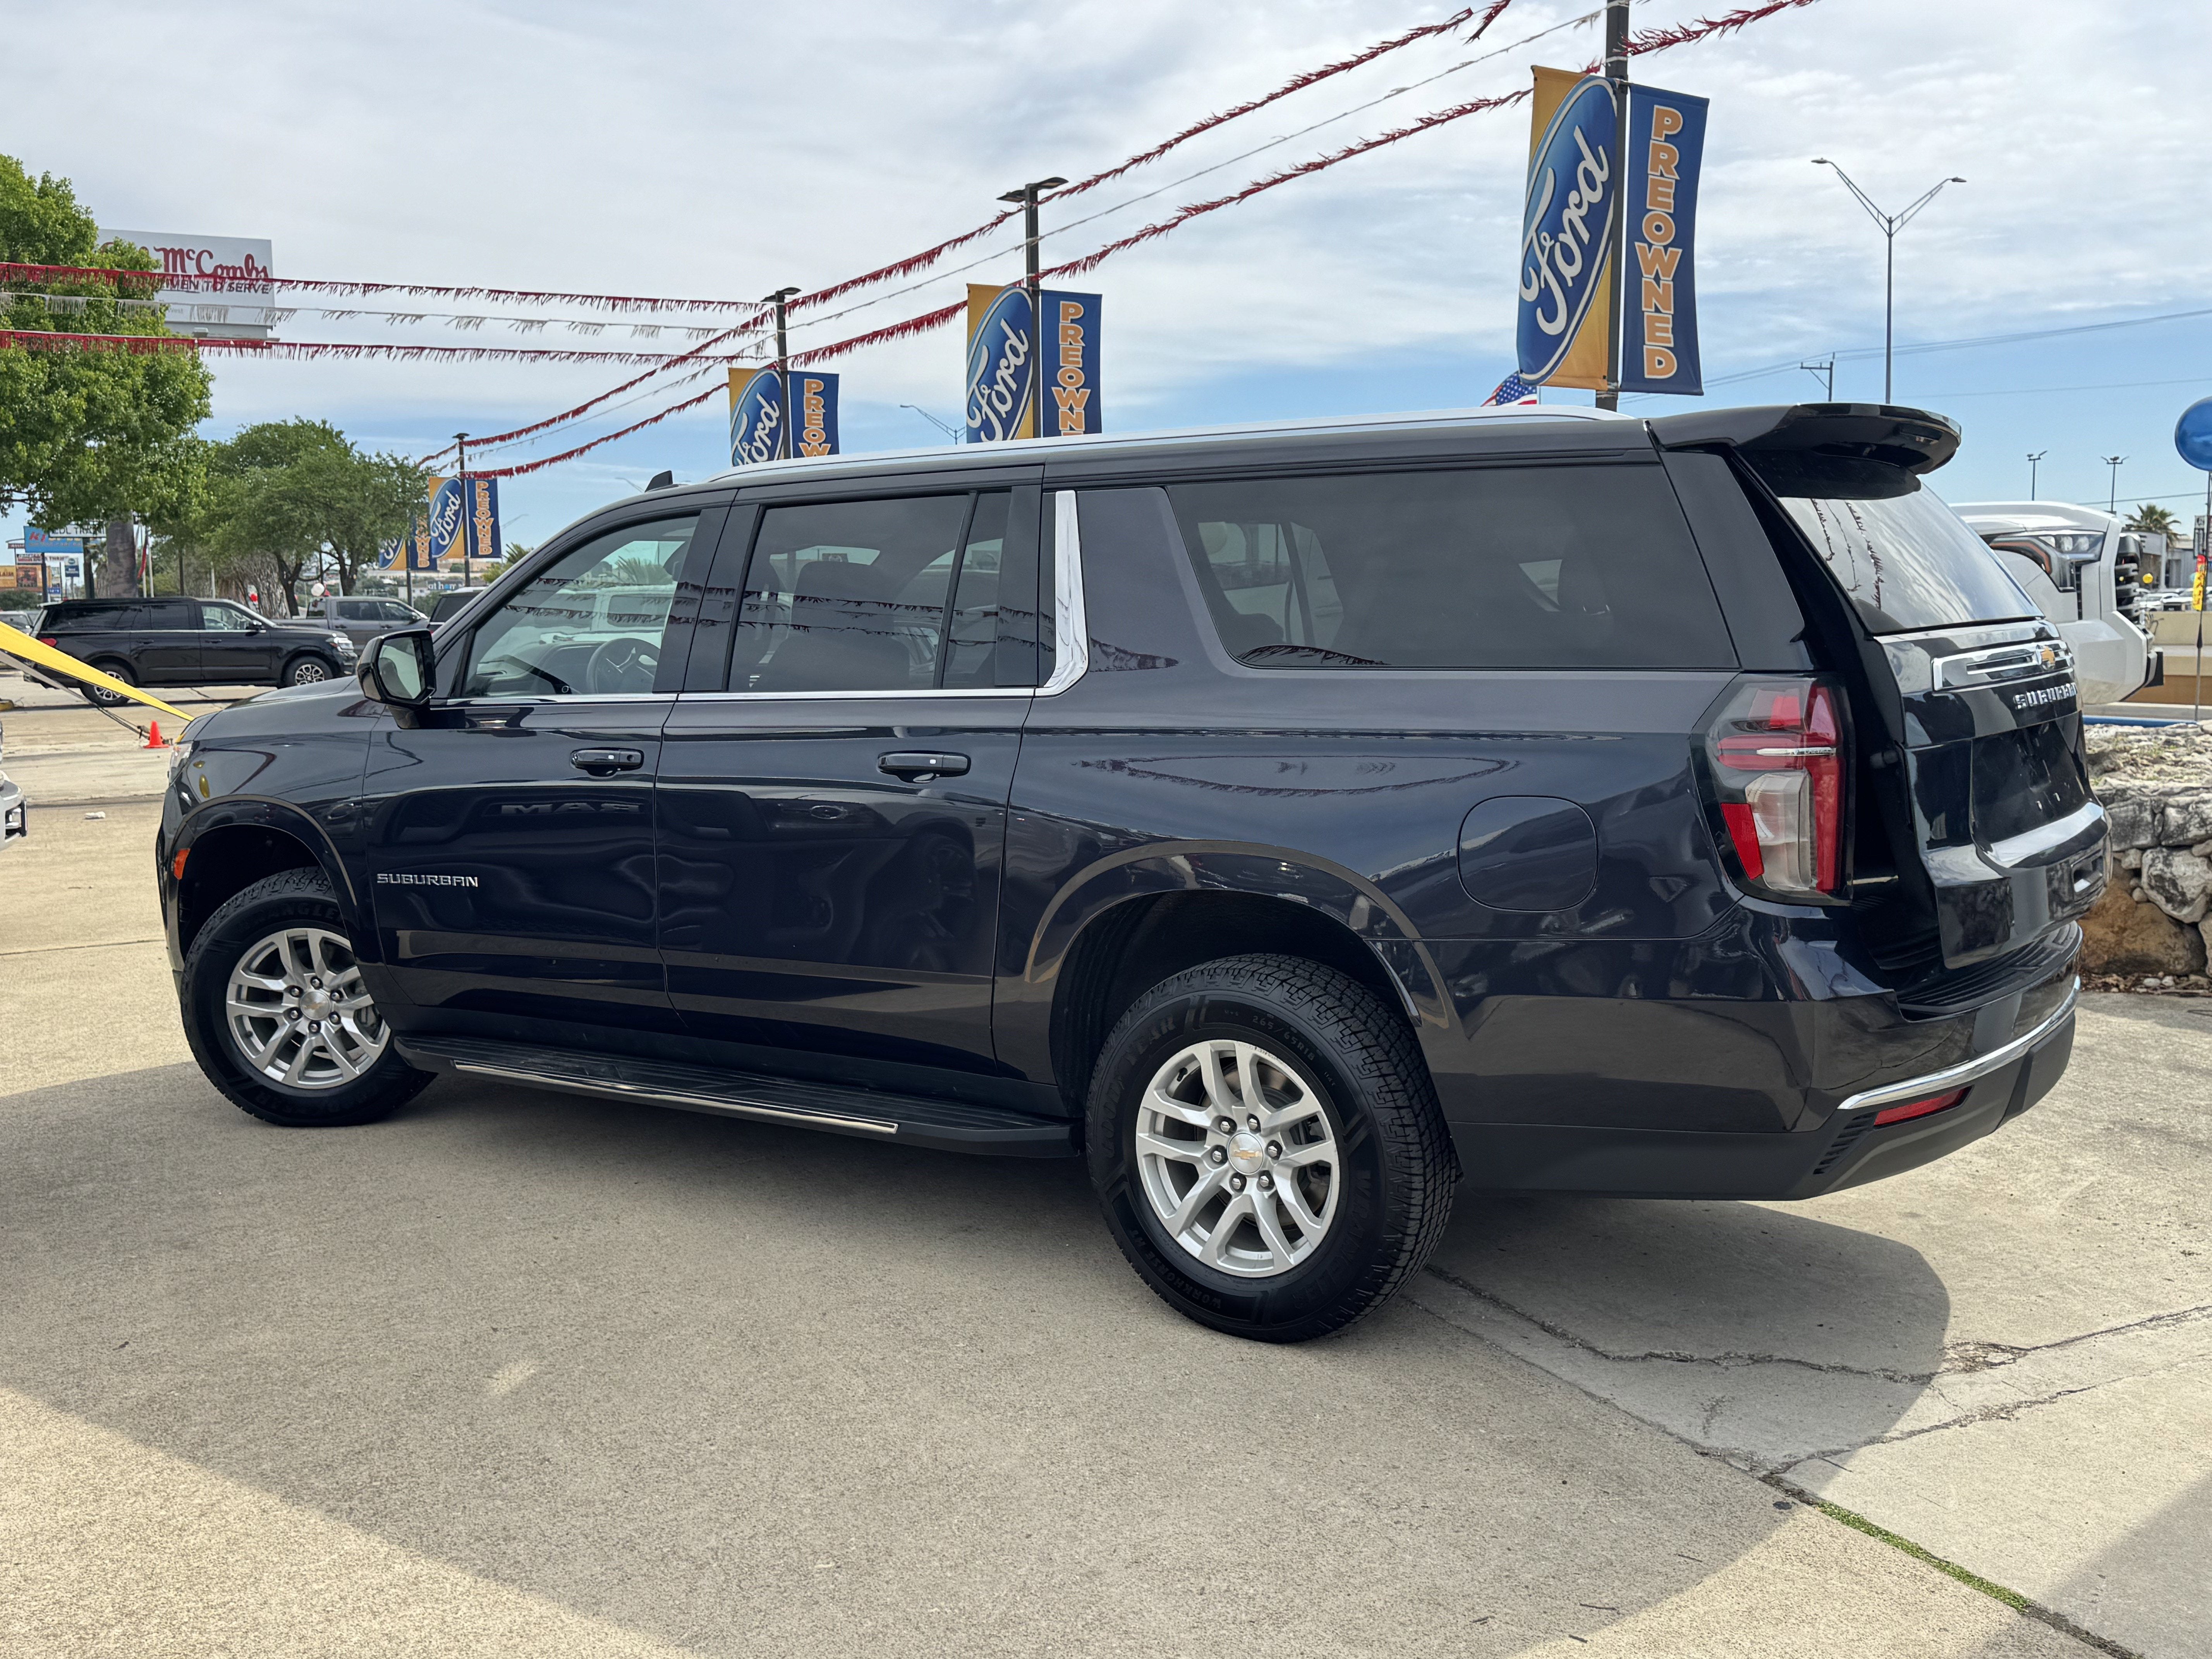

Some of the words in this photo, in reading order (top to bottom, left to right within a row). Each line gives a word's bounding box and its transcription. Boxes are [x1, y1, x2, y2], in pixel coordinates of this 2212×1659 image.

[153, 247, 269, 279] McCombs
[1520, 125, 1609, 335] Ford
[1635, 105, 1683, 379] PREOWNED
[227, 282, 270, 294] SERVE
[967, 318, 1030, 441] Ford
[1051, 301, 1091, 436] PREOWN
[736, 392, 780, 465] Ford
[799, 378, 831, 457] PREOW
[430, 490, 461, 545] Ford
[472, 481, 495, 555] PREOWNED
[377, 873, 478, 888] SUBURBAN
[1252, 1015, 1316, 1061] 265/65R18
[1144, 1251, 1221, 1309] WORKHORSE
